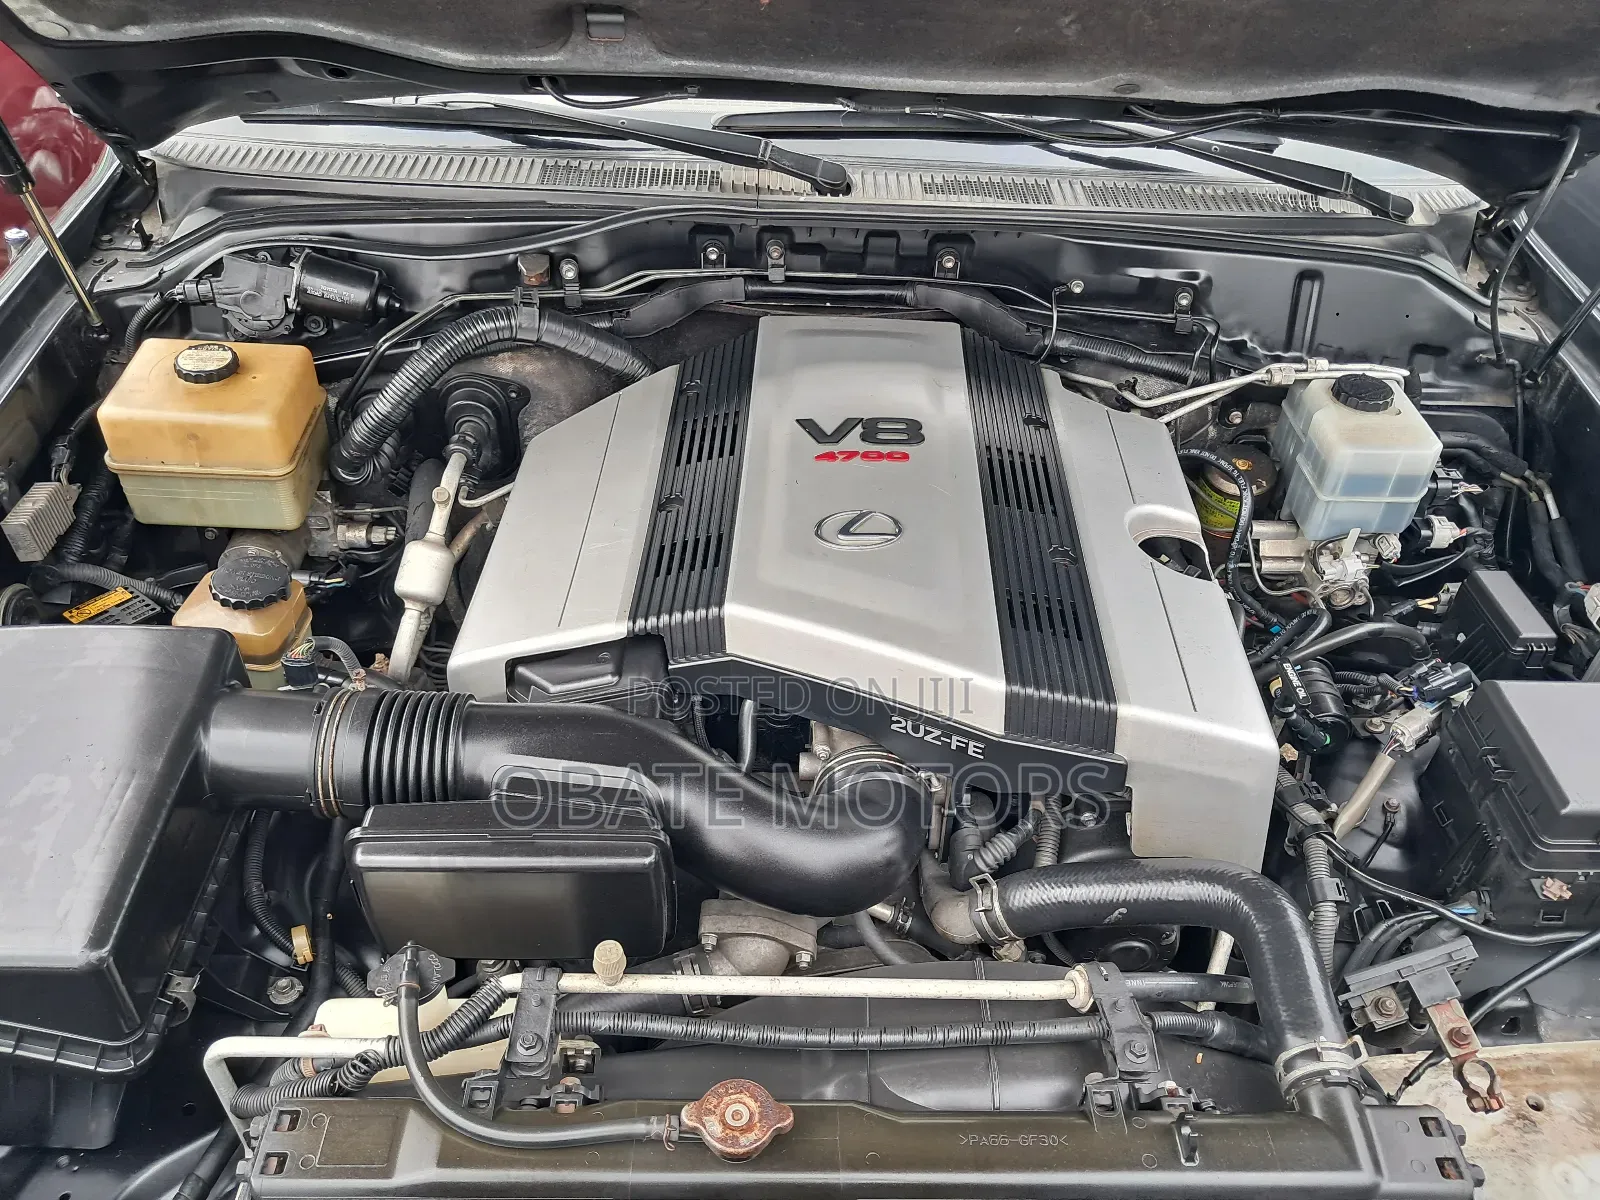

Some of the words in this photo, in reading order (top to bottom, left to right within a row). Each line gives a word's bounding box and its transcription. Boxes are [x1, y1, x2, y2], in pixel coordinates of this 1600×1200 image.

[795, 417, 925, 447] V8
[813, 451, 910, 463] 4700
[1282, 662, 1300, 688] ENGINE
[1296, 686, 1308, 700] OIL
[890, 715, 986, 760] 2UZ-FE
[958, 1133, 1069, 1148] >PA66-GF30<
